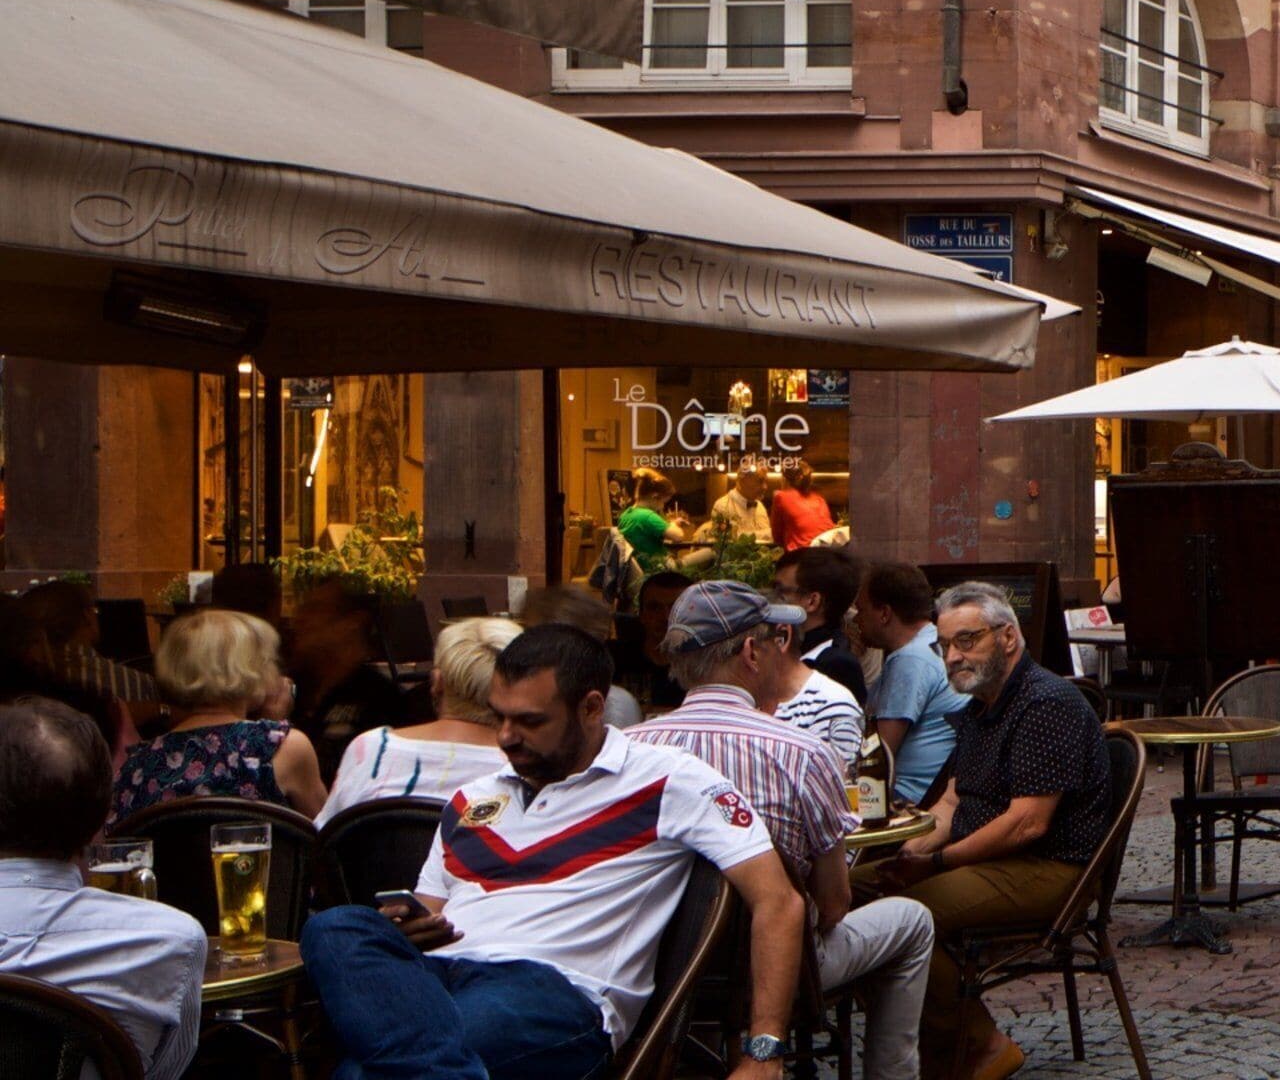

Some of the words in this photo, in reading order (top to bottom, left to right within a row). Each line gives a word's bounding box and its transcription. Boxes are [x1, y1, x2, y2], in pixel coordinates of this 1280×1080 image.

[939, 219, 959, 231] RUE
[963, 219, 977, 230] DU
[957, 234, 1010, 247] TAILLEURS
[589, 242, 878, 330] RESTAURANT
[613, 378, 646, 401] Le
[626, 398, 810, 451] Dôme
[632, 454, 719, 469] restaurant
[739, 452, 802, 473] glacier
